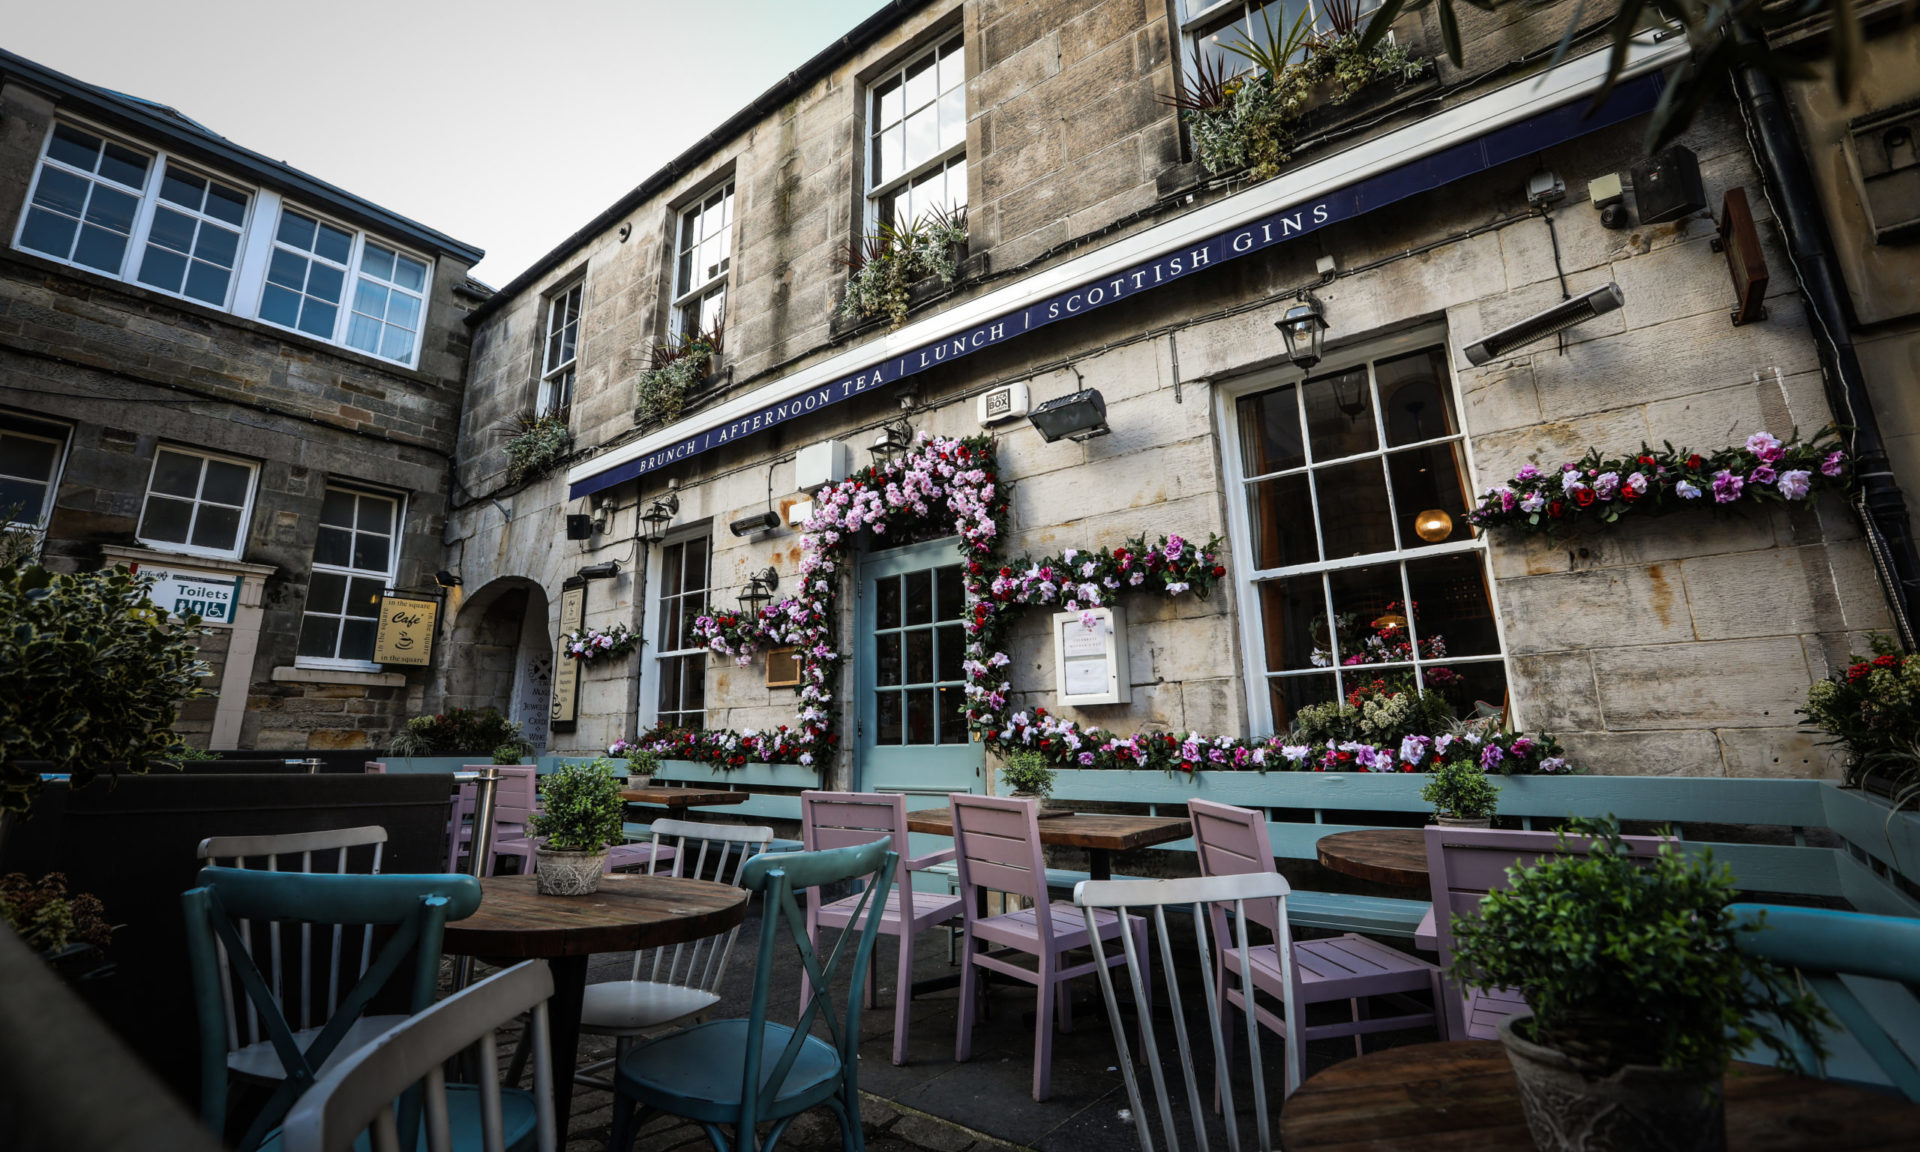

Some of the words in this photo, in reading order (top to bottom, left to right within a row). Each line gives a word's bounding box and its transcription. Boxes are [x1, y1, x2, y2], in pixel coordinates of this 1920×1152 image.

[1048, 245, 1210, 319] SCOTTISH
[1232, 203, 1330, 252] GINS
[919, 322, 1006, 368] LUNCH
[718, 388, 832, 443] AFTERNOON
[842, 369, 884, 397] TEA
[989, 398, 1008, 409] BOX
[639, 440, 697, 473] BRUNCH
[177, 584, 229, 600] Toilets
